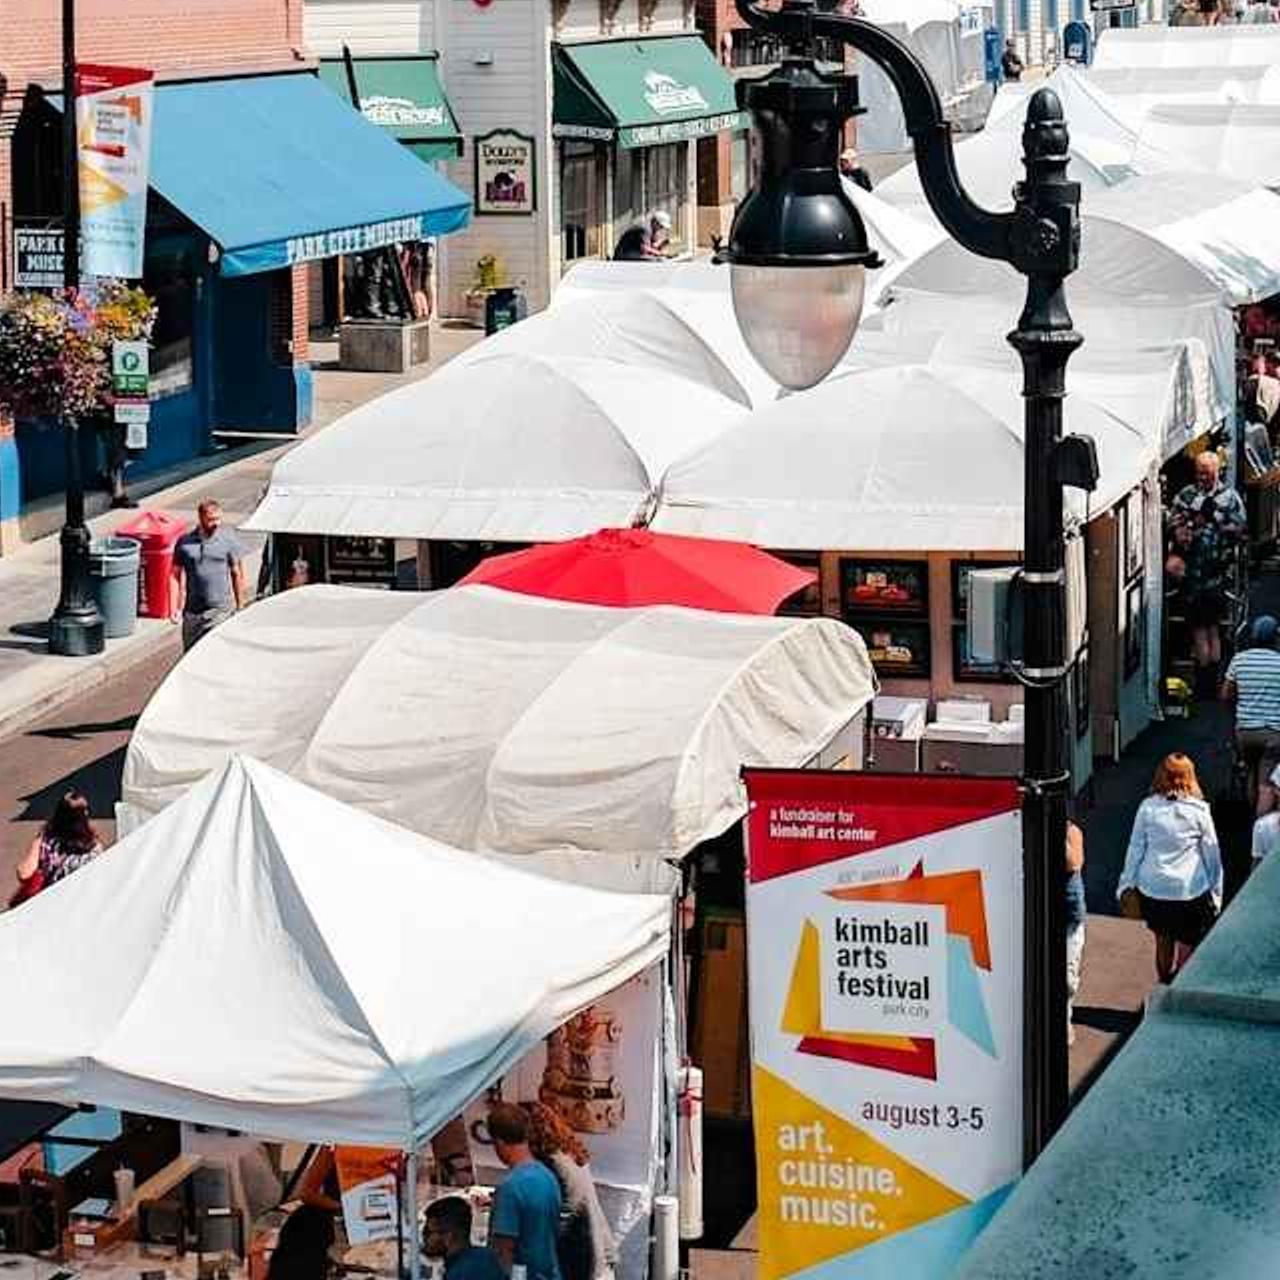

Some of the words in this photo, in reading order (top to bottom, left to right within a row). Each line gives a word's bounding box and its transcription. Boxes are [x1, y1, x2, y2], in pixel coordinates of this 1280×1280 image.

[19, 236, 56, 253] PARK
[780, 807, 835, 823] fundraiser
[838, 809, 855, 823] for
[770, 823, 815, 838] kimball
[817, 827, 835, 839] art
[837, 828, 877, 841] center
[836, 917, 928, 946] kimball
[837, 945, 887, 969] arts
[838, 971, 929, 1000] festival
[862, 1101, 939, 1129] august
[946, 1106, 984, 1130] 3-5
[778, 1121, 833, 1153] art.
[778, 1154, 903, 1196] cuisine.
[780, 1192, 885, 1230] music.
